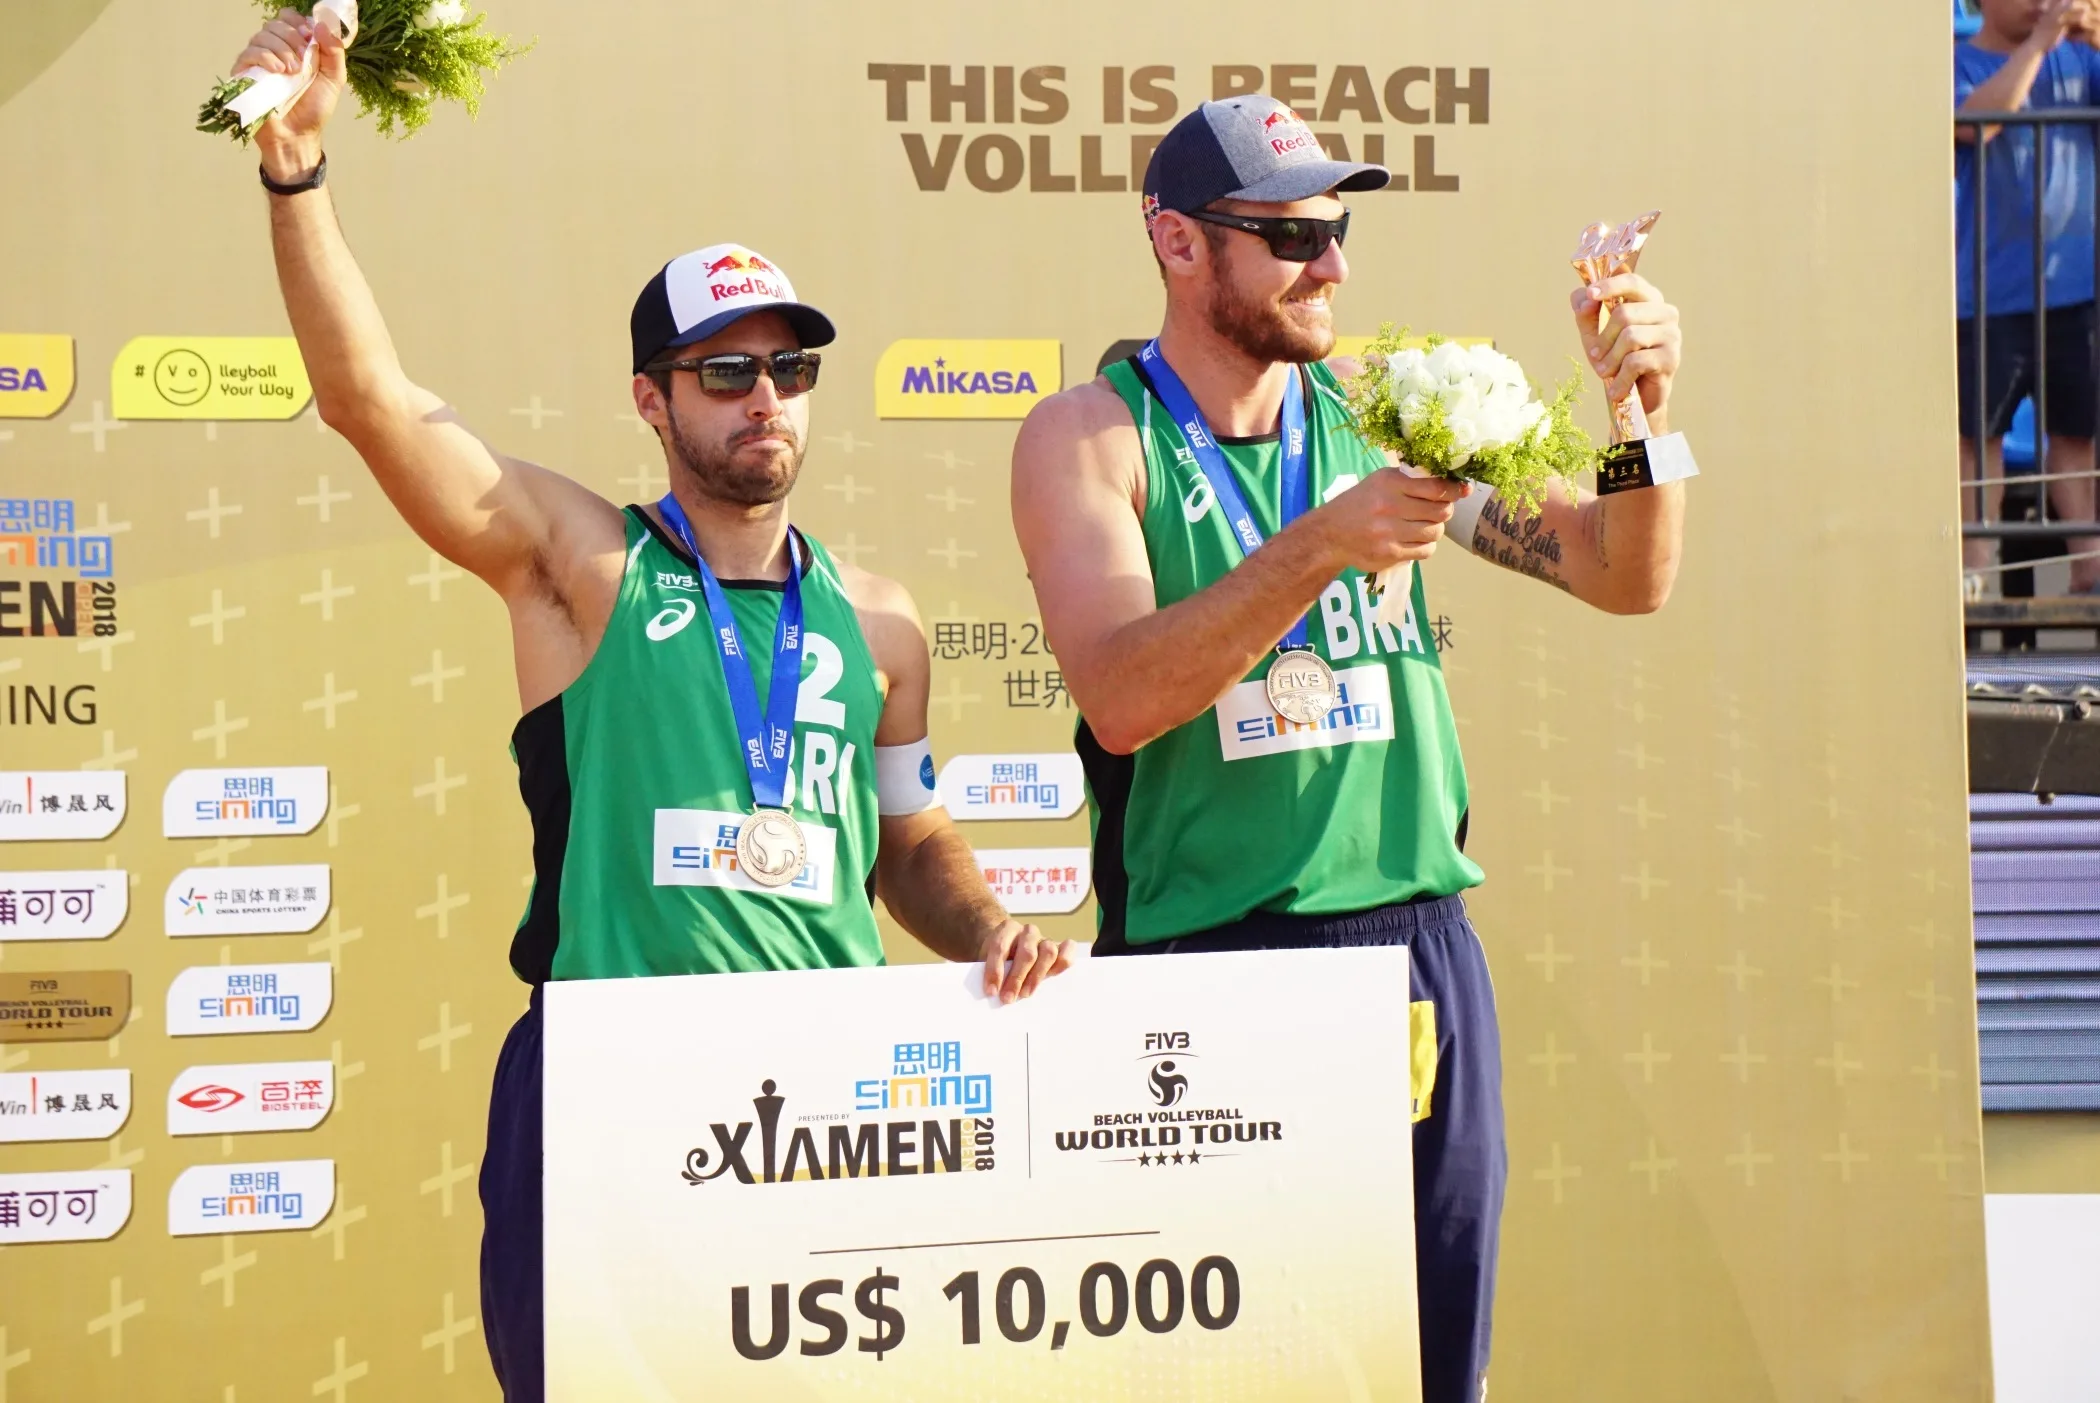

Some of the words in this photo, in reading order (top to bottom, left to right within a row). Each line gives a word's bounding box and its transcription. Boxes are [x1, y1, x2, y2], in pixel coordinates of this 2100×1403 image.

[868, 63, 1069, 124] THIS
[1103, 65, 1178, 124] IS
[1212, 65, 1490, 124] BEACH
[1270, 132, 1306, 156] Red
[711, 278, 753, 302] Red
[754, 278, 787, 302] Bull
[221, 383, 253, 396] Your
[259, 383, 294, 399] Way
[1184, 421, 1207, 450] FIVB
[1291, 427, 1303, 456] FIVB
[0, 500, 74, 532] 思明
[1236, 519, 1258, 548] FIVB
[656, 571, 693, 588] FIVB
[92, 581, 117, 637] 2018
[719, 627, 737, 656] FIVB
[785, 624, 799, 650] FIVB
[794, 632, 846, 730] 2
[747, 737, 764, 768] FIVB
[772, 728, 788, 760] FIVB
[992, 762, 1038, 783] 思明
[223, 777, 273, 798] 思明
[966, 784, 1059, 809] siming
[196, 799, 297, 825] siming
[214, 886, 318, 904] 中国体育彩票
[1024, 884, 1079, 895] SPORT
[215, 906, 240, 914] CHINA
[273, 905, 307, 913] LOTTERY
[29, 980, 59, 990] FIVB
[228, 973, 278, 995] 思明
[58, 1006, 113, 1018] TOUR
[200, 995, 300, 1021] siming
[1145, 1032, 1190, 1050] FIVB
[894, 1041, 961, 1075] 思明
[45, 1093, 120, 1113] 博晟风
[262, 1102, 325, 1112] BIOSTEEL
[856, 1074, 992, 1114] siming
[798, 1114, 839, 1122] PRESENTED
[841, 1113, 850, 1121] BY
[1093, 1112, 1143, 1126] BEACH
[1149, 1107, 1244, 1124] VOLLEYBALL
[682, 1078, 963, 1185] XIAMEN
[974, 1117, 995, 1171] 2018
[1055, 1126, 1182, 1151] WORLD
[1189, 1121, 1282, 1145] TOUR
[230, 1171, 280, 1194] 思明
[202, 1193, 303, 1220] siming
[731, 1266, 906, 1361] US$
[941, 1255, 1241, 1350] 10,000
